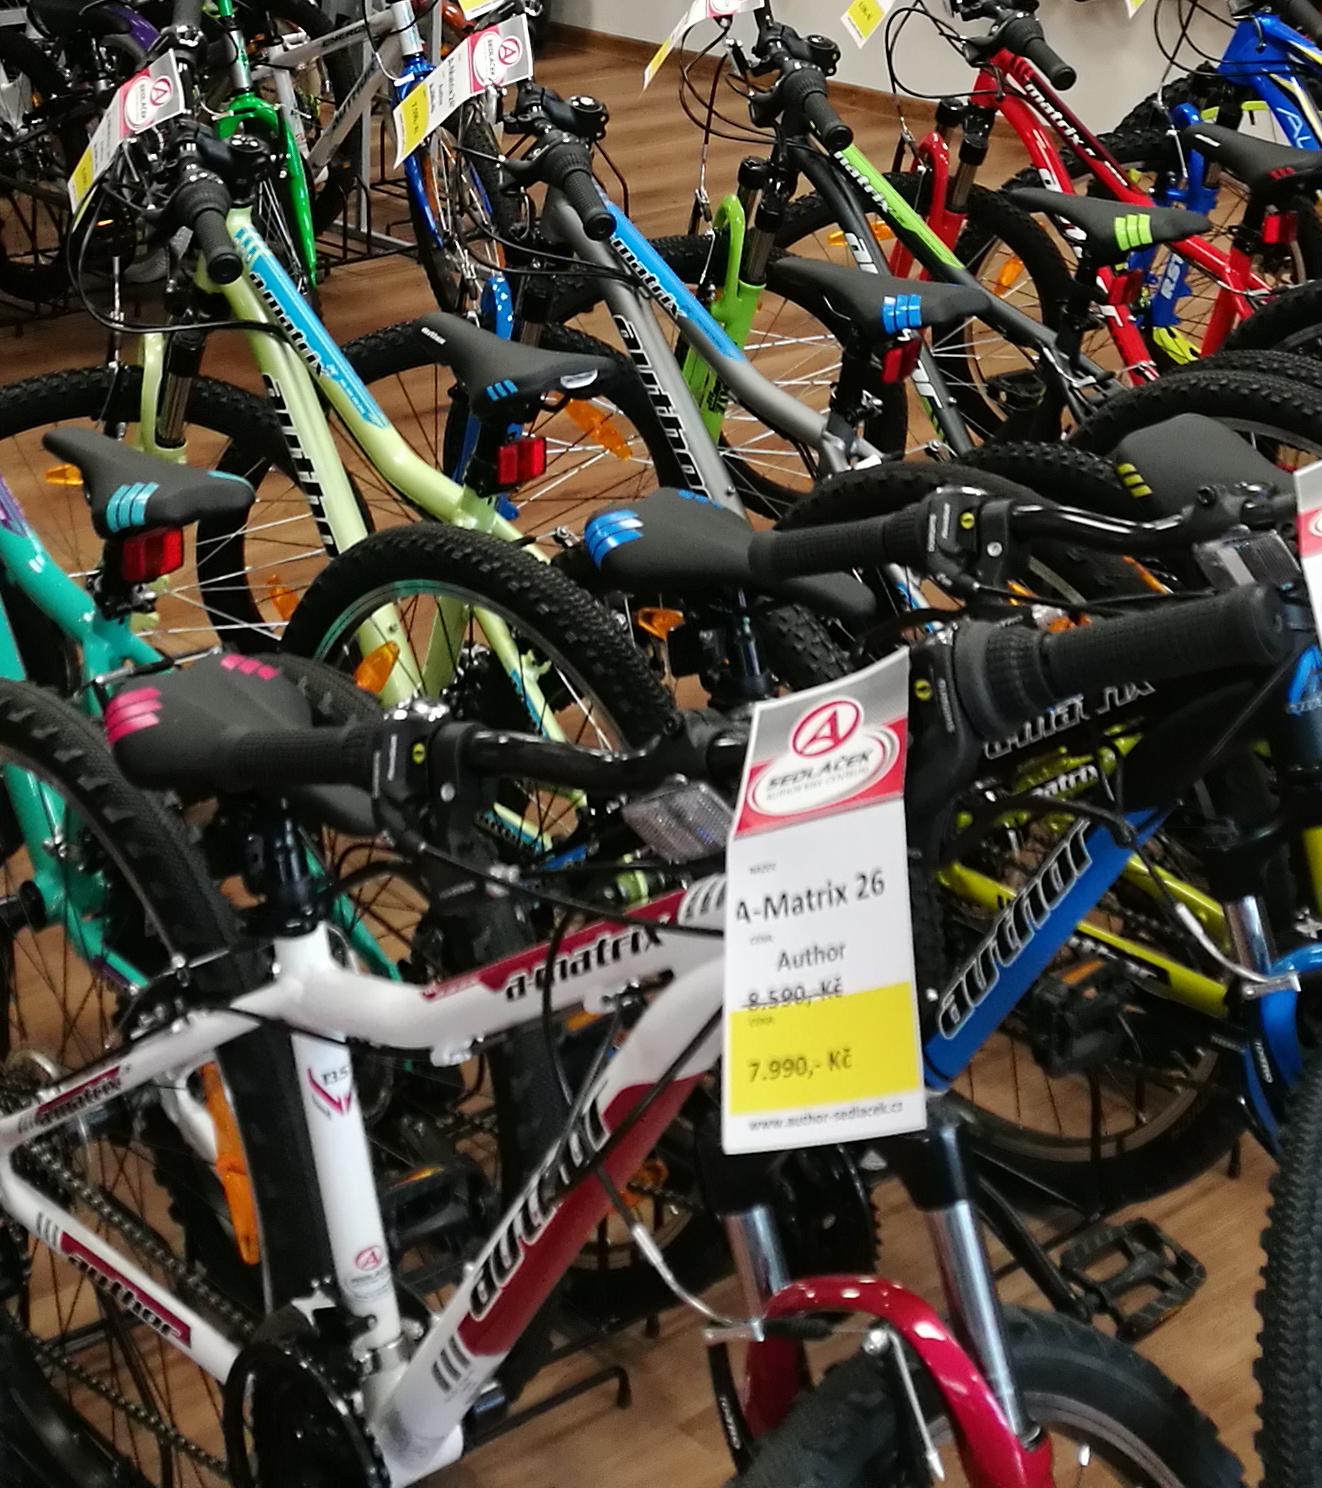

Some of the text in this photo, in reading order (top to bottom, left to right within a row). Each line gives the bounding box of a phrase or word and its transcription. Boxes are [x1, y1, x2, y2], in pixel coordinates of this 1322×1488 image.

[768, 748, 874, 788] SEDLAČEK
[735, 868, 886, 924] A-Matrix 26
[777, 942, 847, 973] Author
[820, 976, 845, 1000] Kč
[748, 1046, 853, 1083] 7.990,- Kč
[748, 1101, 904, 1132] www.author-sedlacek.cz
